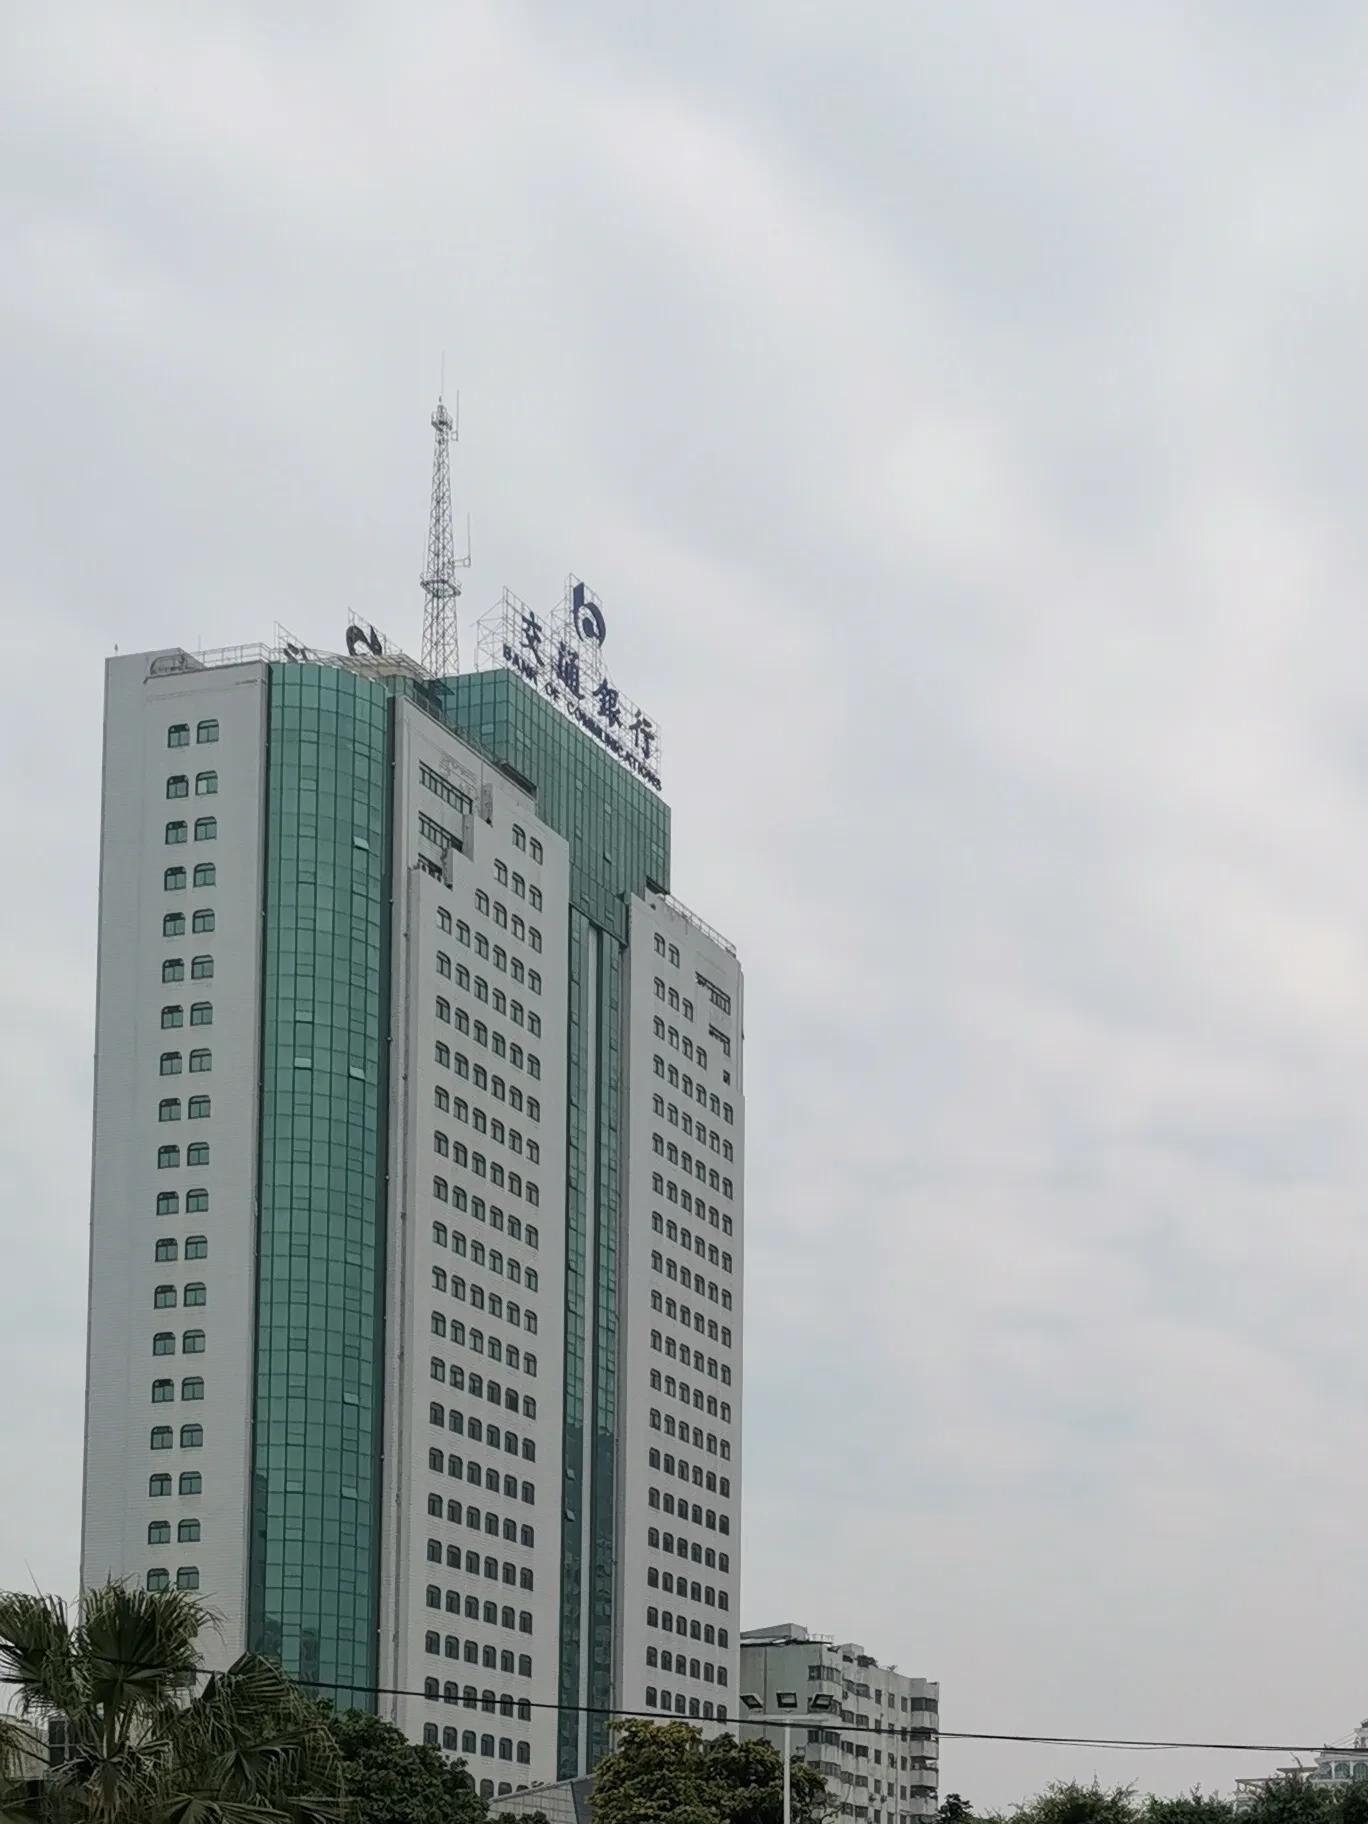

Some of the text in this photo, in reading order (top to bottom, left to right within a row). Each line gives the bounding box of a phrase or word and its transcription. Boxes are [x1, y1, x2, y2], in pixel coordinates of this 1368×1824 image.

[503, 643, 662, 791] BANK OF COMMUNICATIONS
[520, 611, 655, 759] 交通银行
